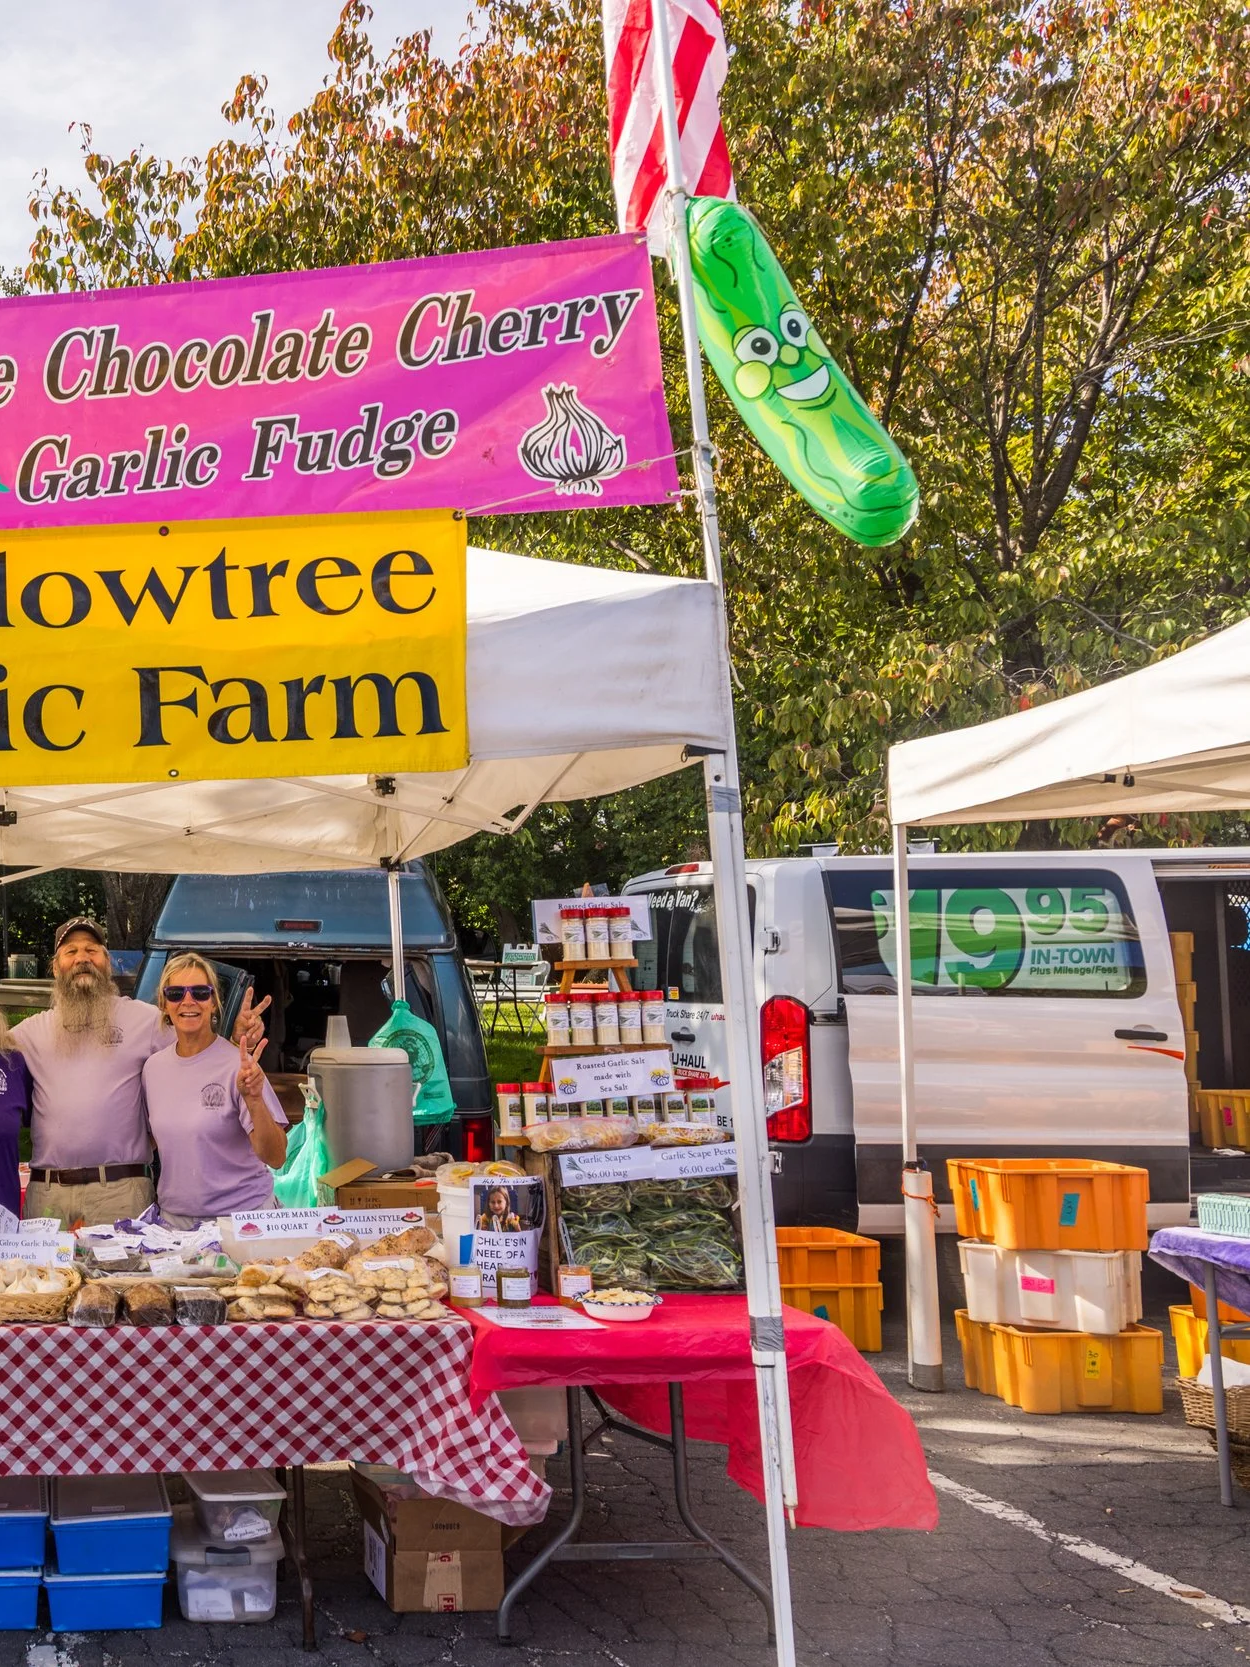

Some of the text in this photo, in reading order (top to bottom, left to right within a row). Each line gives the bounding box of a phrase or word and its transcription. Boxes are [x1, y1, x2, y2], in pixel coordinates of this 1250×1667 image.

[45, 309, 370, 402] Chocolate
[396, 288, 643, 371] Cherry
[16, 402, 460, 506] Garlic Fudge
[132, 665, 451, 748] Farm
[675, 889, 699, 908] Van?
[558, 901, 625, 911] Roasted Garlic Salt
[1030, 947, 1116, 966] IN-TOWN
[1029, 966, 1119, 977] Plus Mileage/Fees
[665, 1007, 680, 1019] Truck
[680, 1008, 695, 1020] Share
[695, 1010, 710, 1022] 24/7
[576, 1057, 646, 1071] Roasted Garlic Salt
[593, 1071, 632, 1082] made with
[600, 1084, 629, 1093] Sea Salt
[716, 1115, 728, 1128] BE
[578, 1153, 632, 1165] Garlic Scapes
[661, 1147, 737, 1162] Garlic Scape Pesto
[587, 1168, 628, 1180] $6.00 bag
[678, 1162, 725, 1176] $6.00 each
[235, 1210, 321, 1221] GARLIC SCAPE MARIN
[345, 1213, 401, 1224] ITALIAN STYLE
[266, 1222, 309, 1233] $10 QUART
[0, 1238, 19, 1249] Gilroy
[20, 1239, 41, 1248] Garlic
[519, 1236, 528, 1246] IN
[21, 1252, 37, 1261] each
[476, 1261, 508, 1271] HEAR
